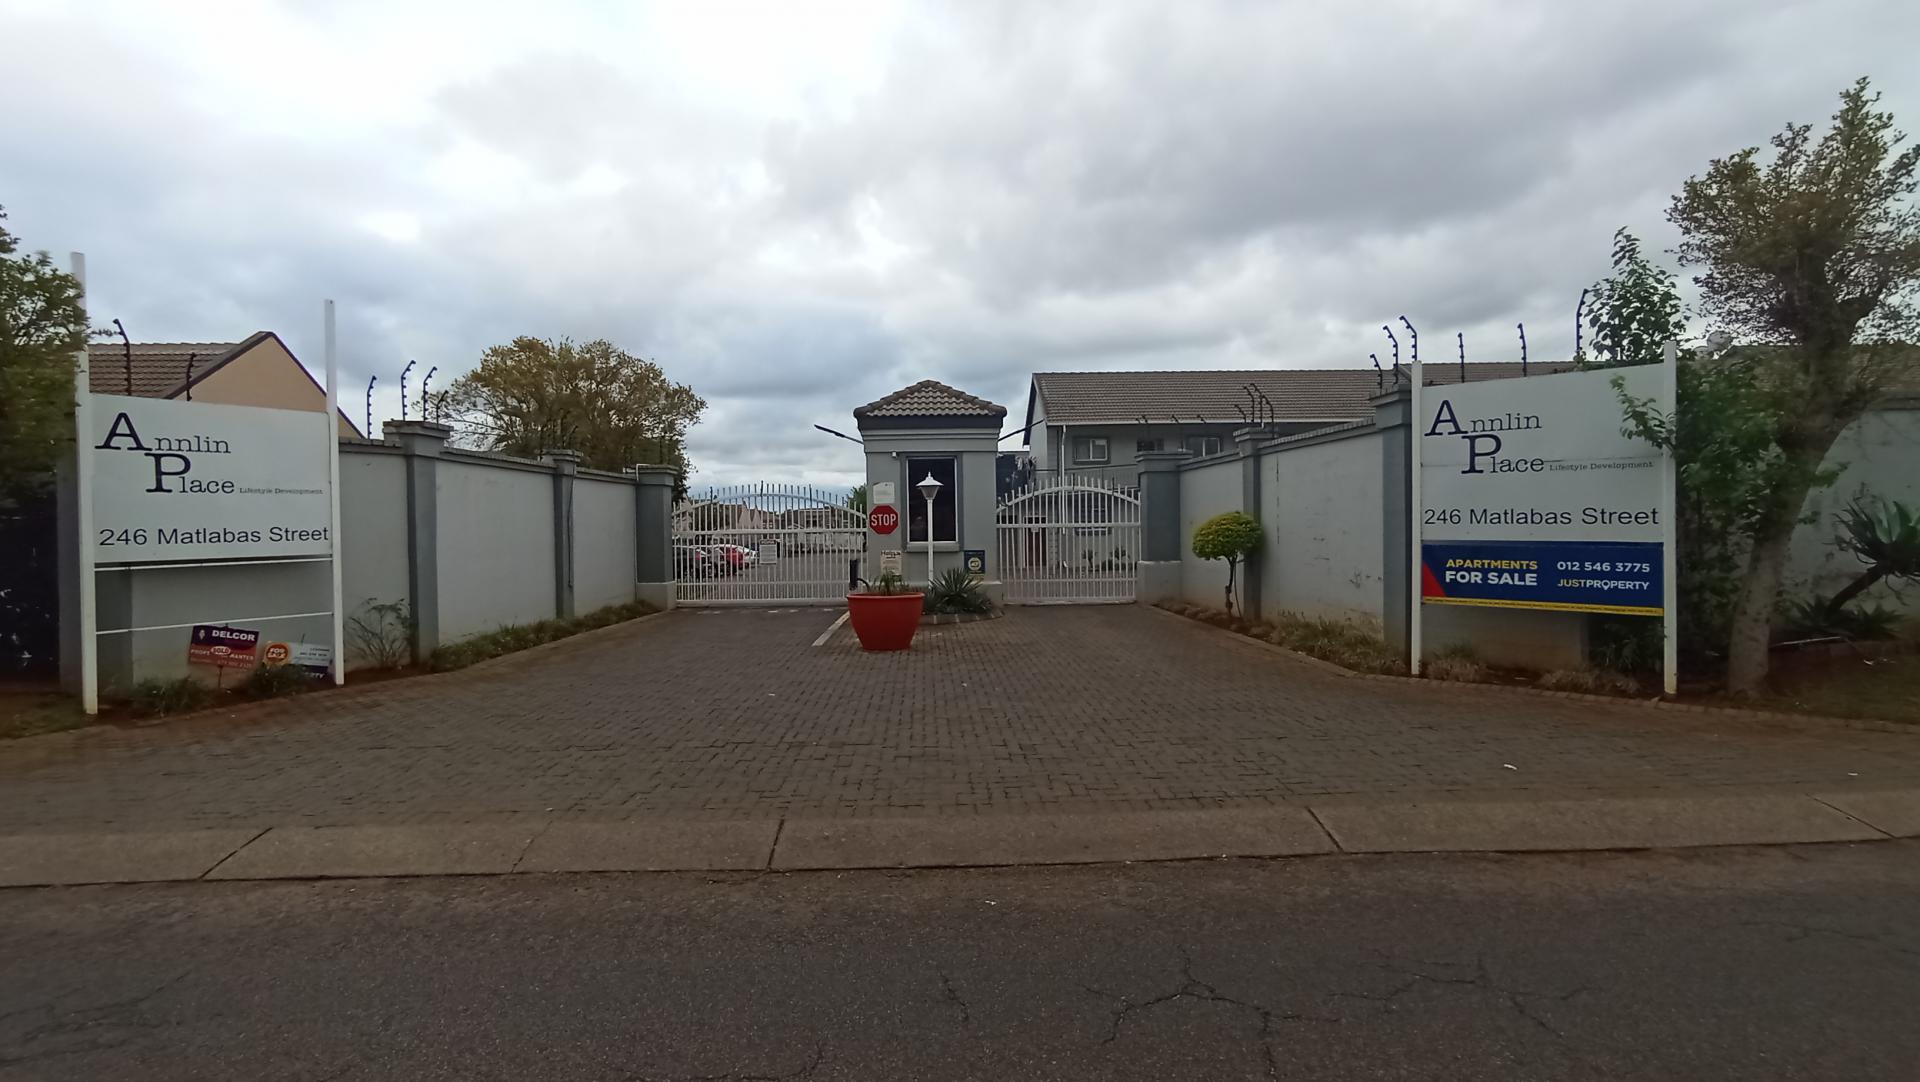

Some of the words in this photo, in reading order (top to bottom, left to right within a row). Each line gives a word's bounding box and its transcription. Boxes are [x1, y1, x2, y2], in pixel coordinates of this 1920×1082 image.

[1424, 399, 1543, 437] Annlin
[95, 412, 232, 454] Annlin
[1461, 433, 1545, 475] Place
[1549, 463, 1588, 472] Lifestyle
[1591, 461, 1655, 470] Development
[144, 452, 235, 494] Place
[870, 513, 897, 527] STOP
[1424, 508, 1462, 526] 246
[1470, 508, 1572, 526] Matlabas
[1582, 507, 1660, 526] Street
[99, 528, 148, 546] 246
[158, 527, 262, 545] Matlabas
[269, 526, 330, 543] Street
[1446, 559, 1539, 571] APARTMENTS
[1557, 561, 1581, 572] 012
[1584, 562, 1611, 572] 546
[1616, 562, 1651, 574] 3775
[1445, 571, 1483, 584] FOR
[1487, 573, 1539, 587] SALE
[1557, 579, 1650, 591] JUSTPROPERTY
[212, 630, 255, 641] DELCOR
